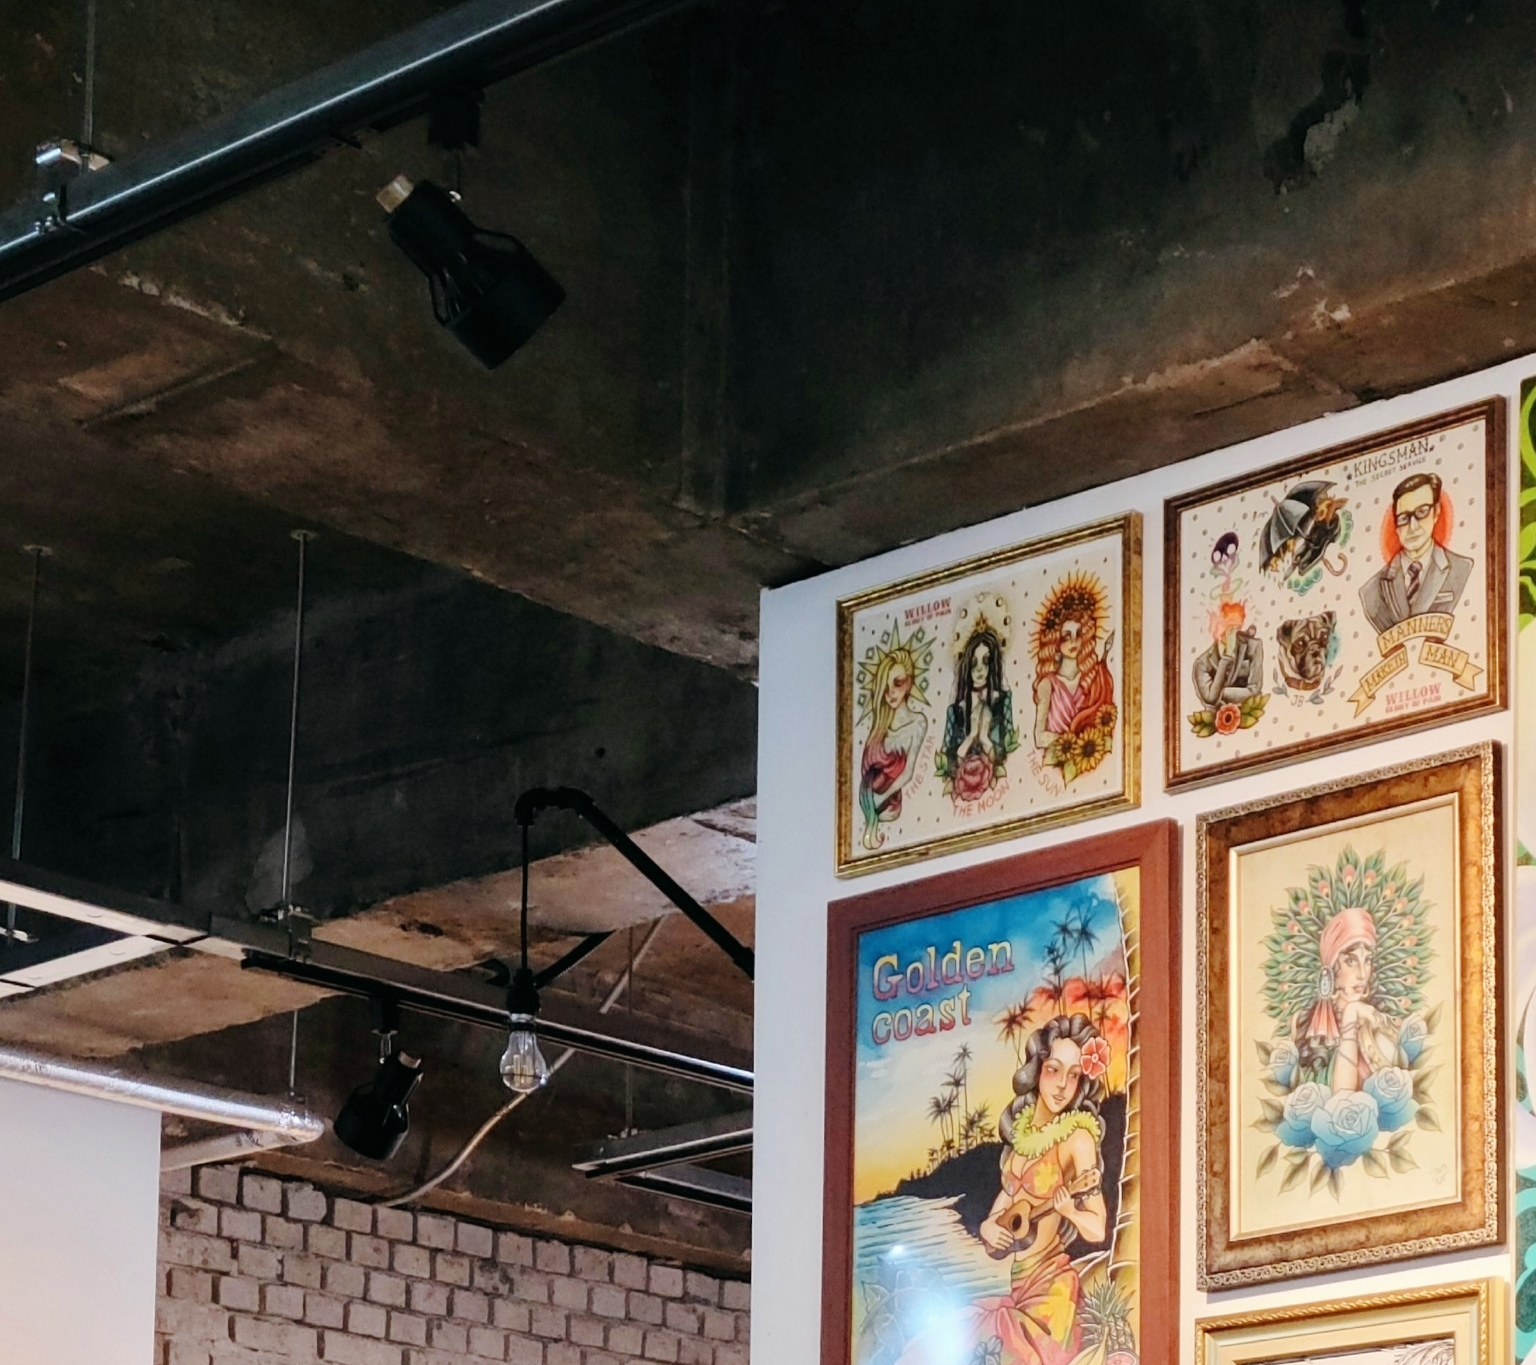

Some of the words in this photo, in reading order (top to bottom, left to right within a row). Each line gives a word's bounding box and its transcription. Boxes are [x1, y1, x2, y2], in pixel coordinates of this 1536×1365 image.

[1353, 437, 1429, 477] KINGSMAN
[904, 597, 951, 620] WILLOW
[1382, 614, 1452, 650] MANNERS
[1424, 645, 1461, 669] MAN
[1385, 682, 1442, 706] WILLOW
[953, 804, 973, 817] THE
[978, 777, 1010, 814] MOON
[873, 939, 1015, 1002] Golden
[872, 983, 972, 1045] coast
